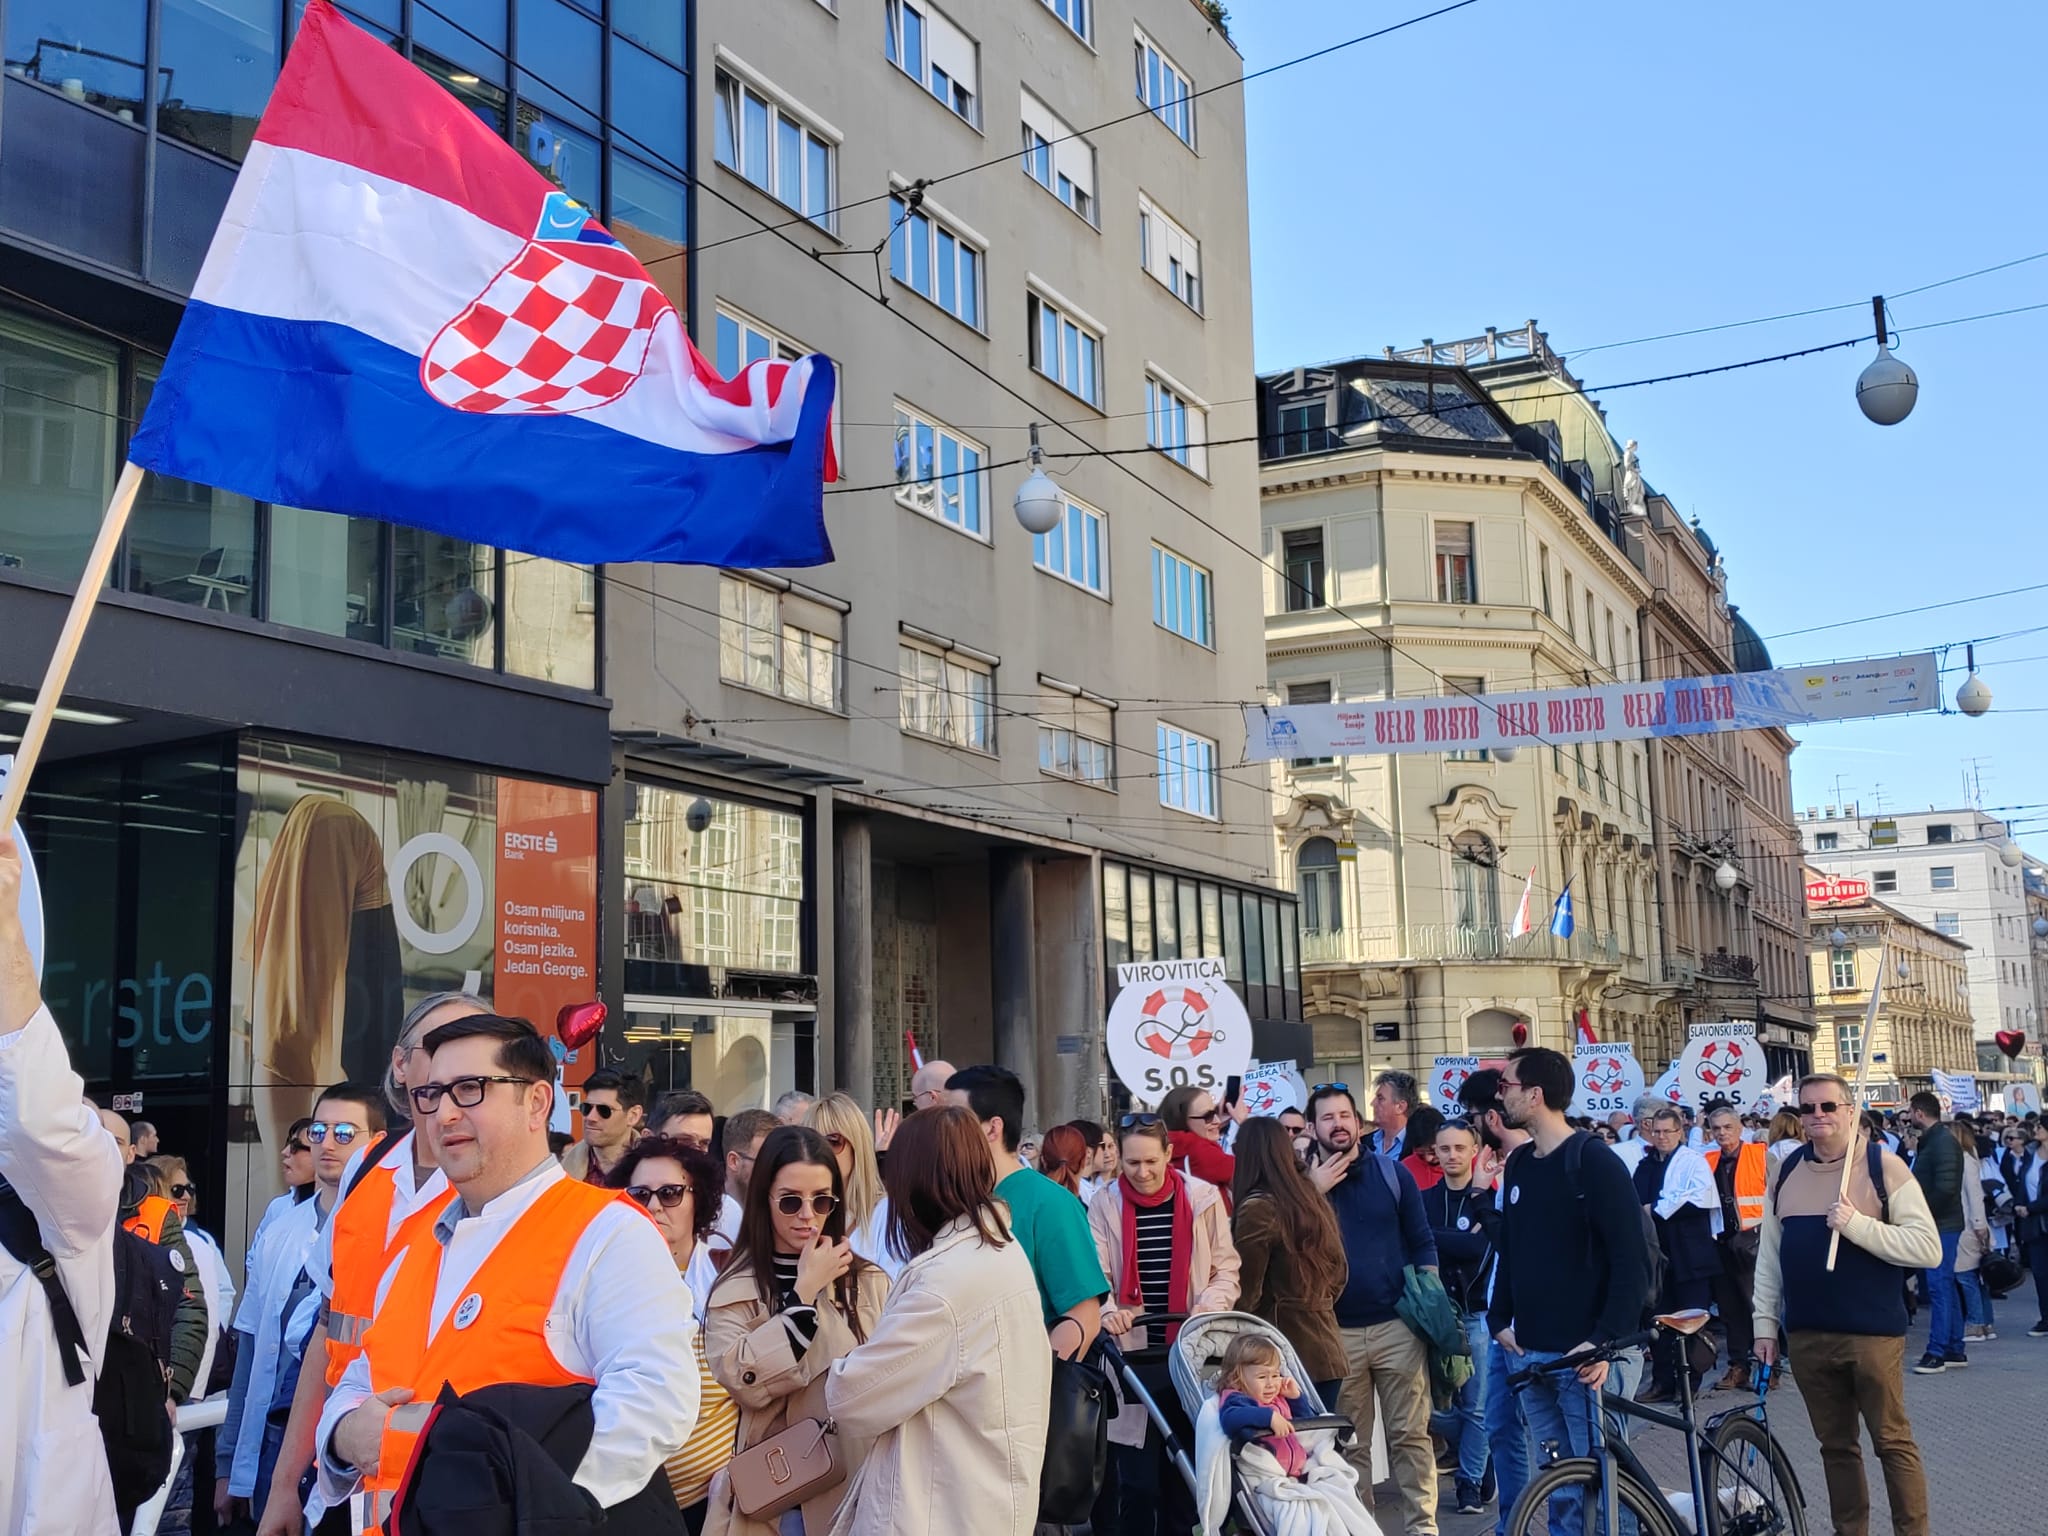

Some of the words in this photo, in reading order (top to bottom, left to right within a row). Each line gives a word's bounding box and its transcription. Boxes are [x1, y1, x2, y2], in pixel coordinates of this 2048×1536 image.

[1375, 709, 1416, 744] VELO
[1424, 706, 1480, 742] MISTO
[1496, 701, 1540, 737] VELO
[1547, 697, 1606, 734] MISTO
[1623, 692, 1667, 728] VELO
[1674, 686, 1735, 724] MISTO
[504, 831, 544, 851] ERSTE
[504, 849, 525, 860] Bank
[504, 901, 539, 917] Osam
[541, 904, 585, 923] milijuna
[504, 920, 561, 938] korisnika.
[504, 939, 539, 955] Osam
[540, 942, 578, 959] jezika.
[503, 959, 540, 975] Jedan
[542, 961, 588, 980] George.
[1121, 960, 1224, 983] VIROVITICA
[1690, 1024, 1732, 1038] SLAVONSKI
[1733, 1024, 1754, 1036] BROD
[1576, 1043, 1631, 1056] DUBROVNIK
[1434, 1056, 1479, 1067] KOPRIVNICA
[1144, 1064, 1223, 1092] S.O.S.
[1244, 1068, 1279, 1081] RIJEKA
[1587, 1097, 1629, 1111] S.O.S.
[1698, 1090, 1746, 1106] SOS.
